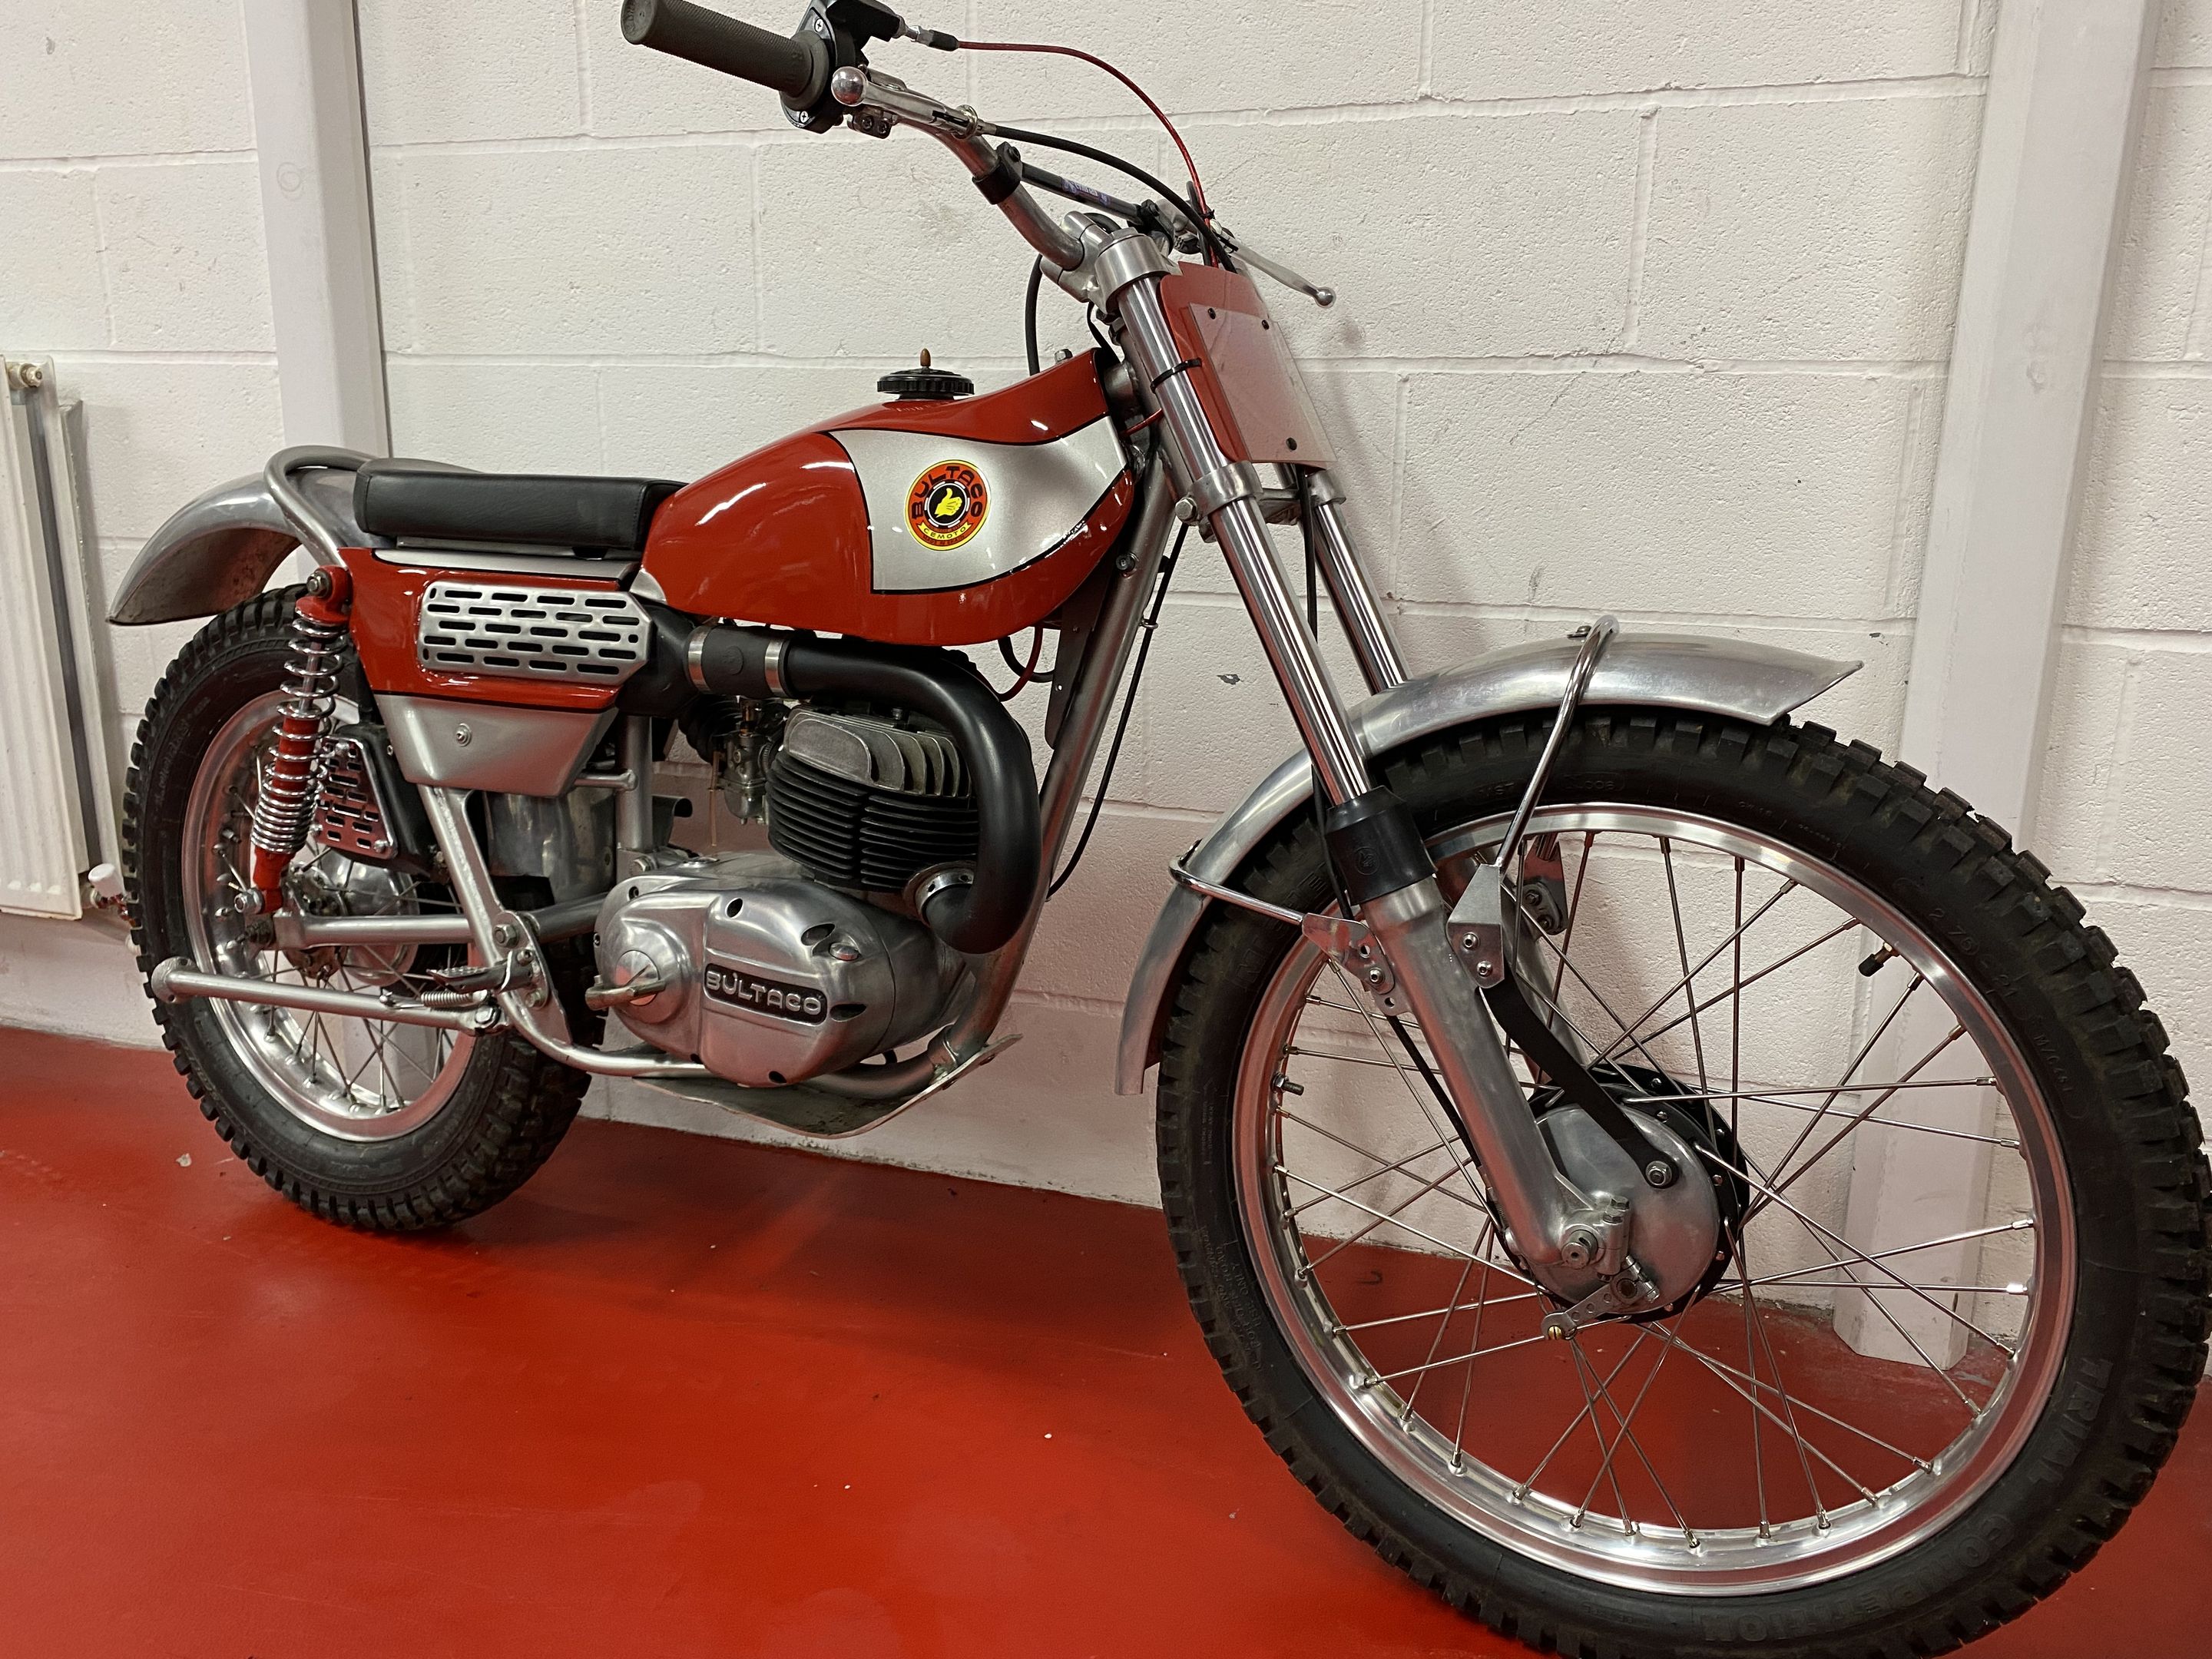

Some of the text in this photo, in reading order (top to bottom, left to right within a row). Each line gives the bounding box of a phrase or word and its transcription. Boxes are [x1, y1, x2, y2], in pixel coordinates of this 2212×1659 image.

[911, 465, 983, 519] BULTACO
[923, 526, 966, 539] CEMOTO
[706, 970, 822, 1016] BULTACO
